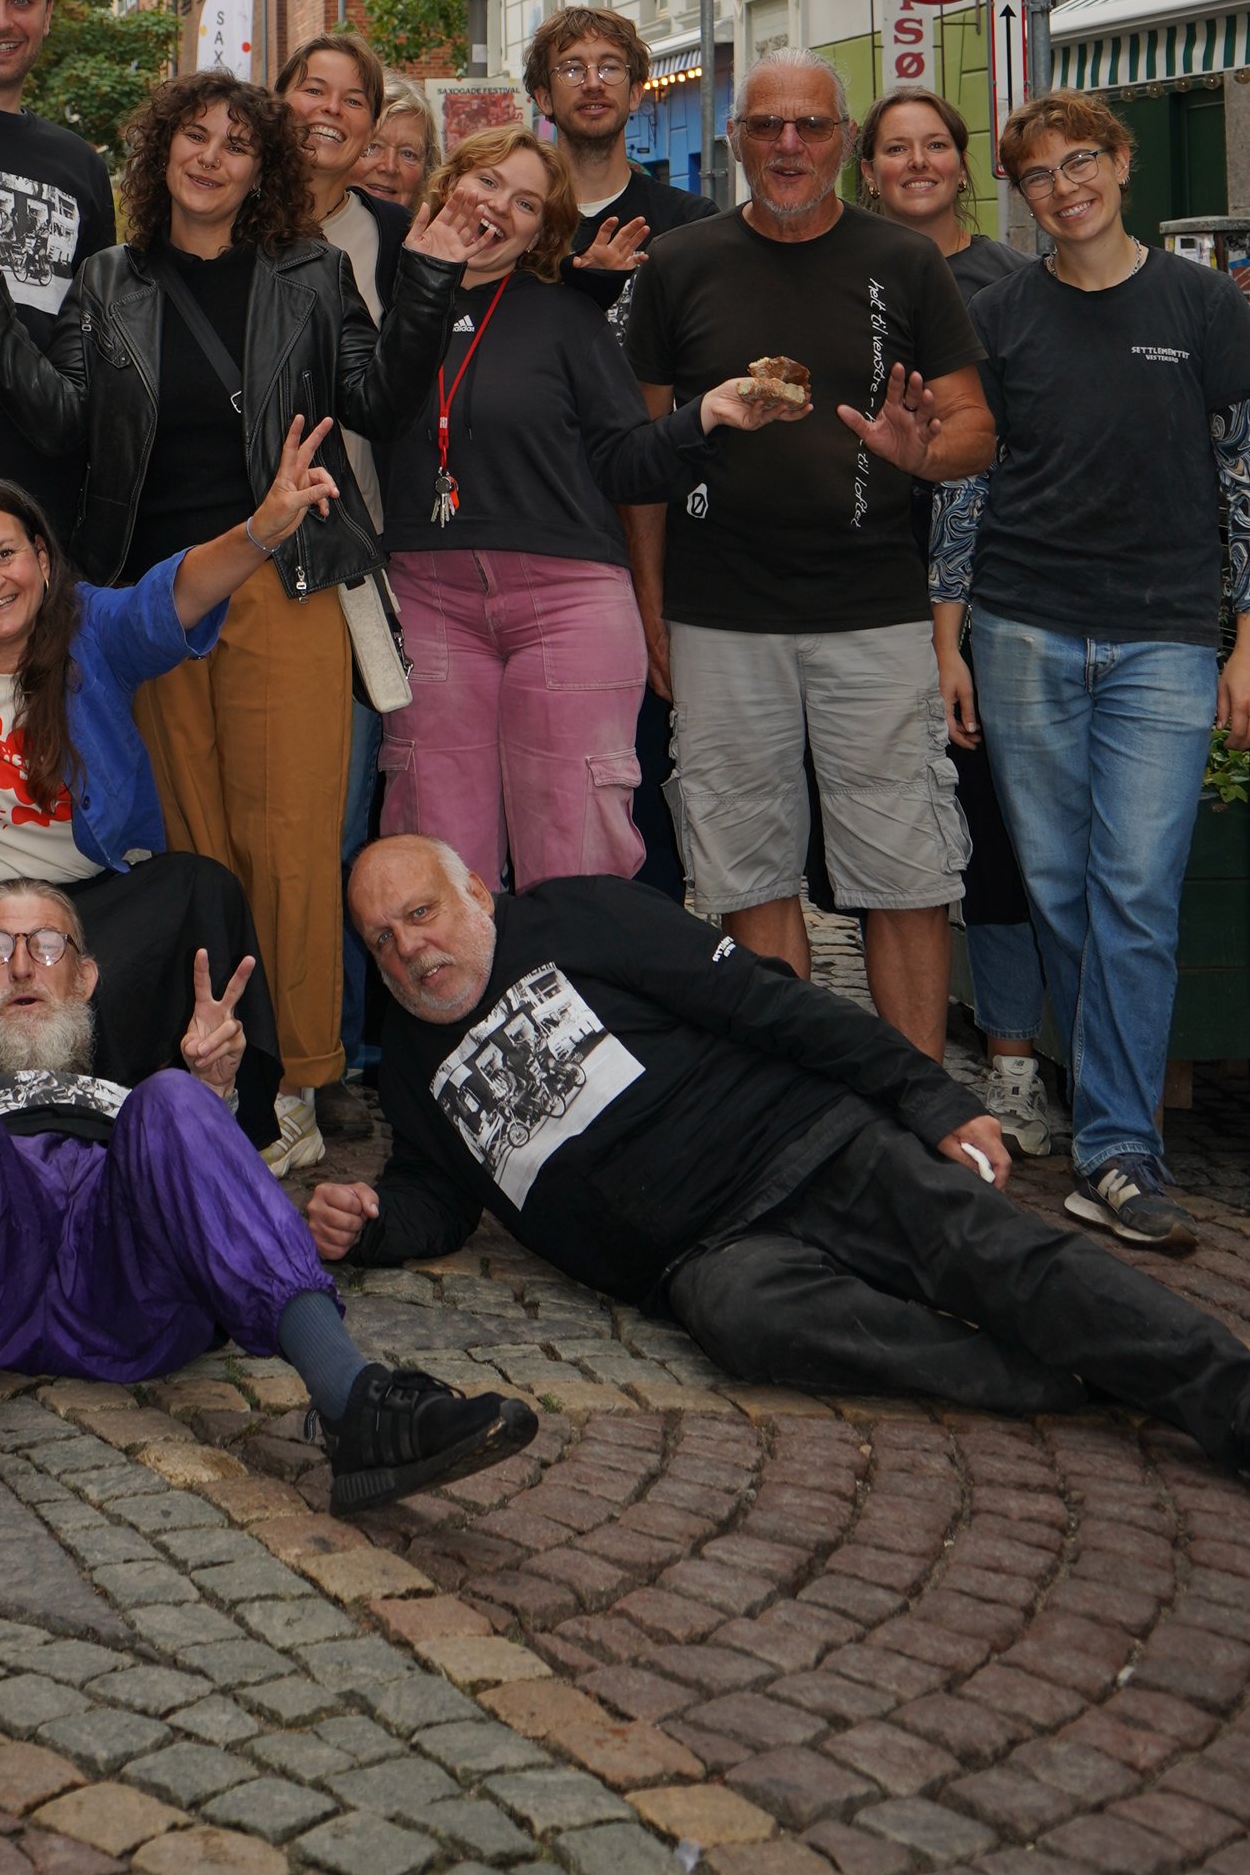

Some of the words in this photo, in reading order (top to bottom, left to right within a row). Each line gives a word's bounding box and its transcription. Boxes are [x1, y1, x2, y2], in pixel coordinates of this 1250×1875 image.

[483, 86, 521, 95] FESTIVAL
[868, 278, 886, 311] helt
[870, 314, 889, 335] til
[870, 336, 886, 392] venstre
[857, 453, 870, 475] til
